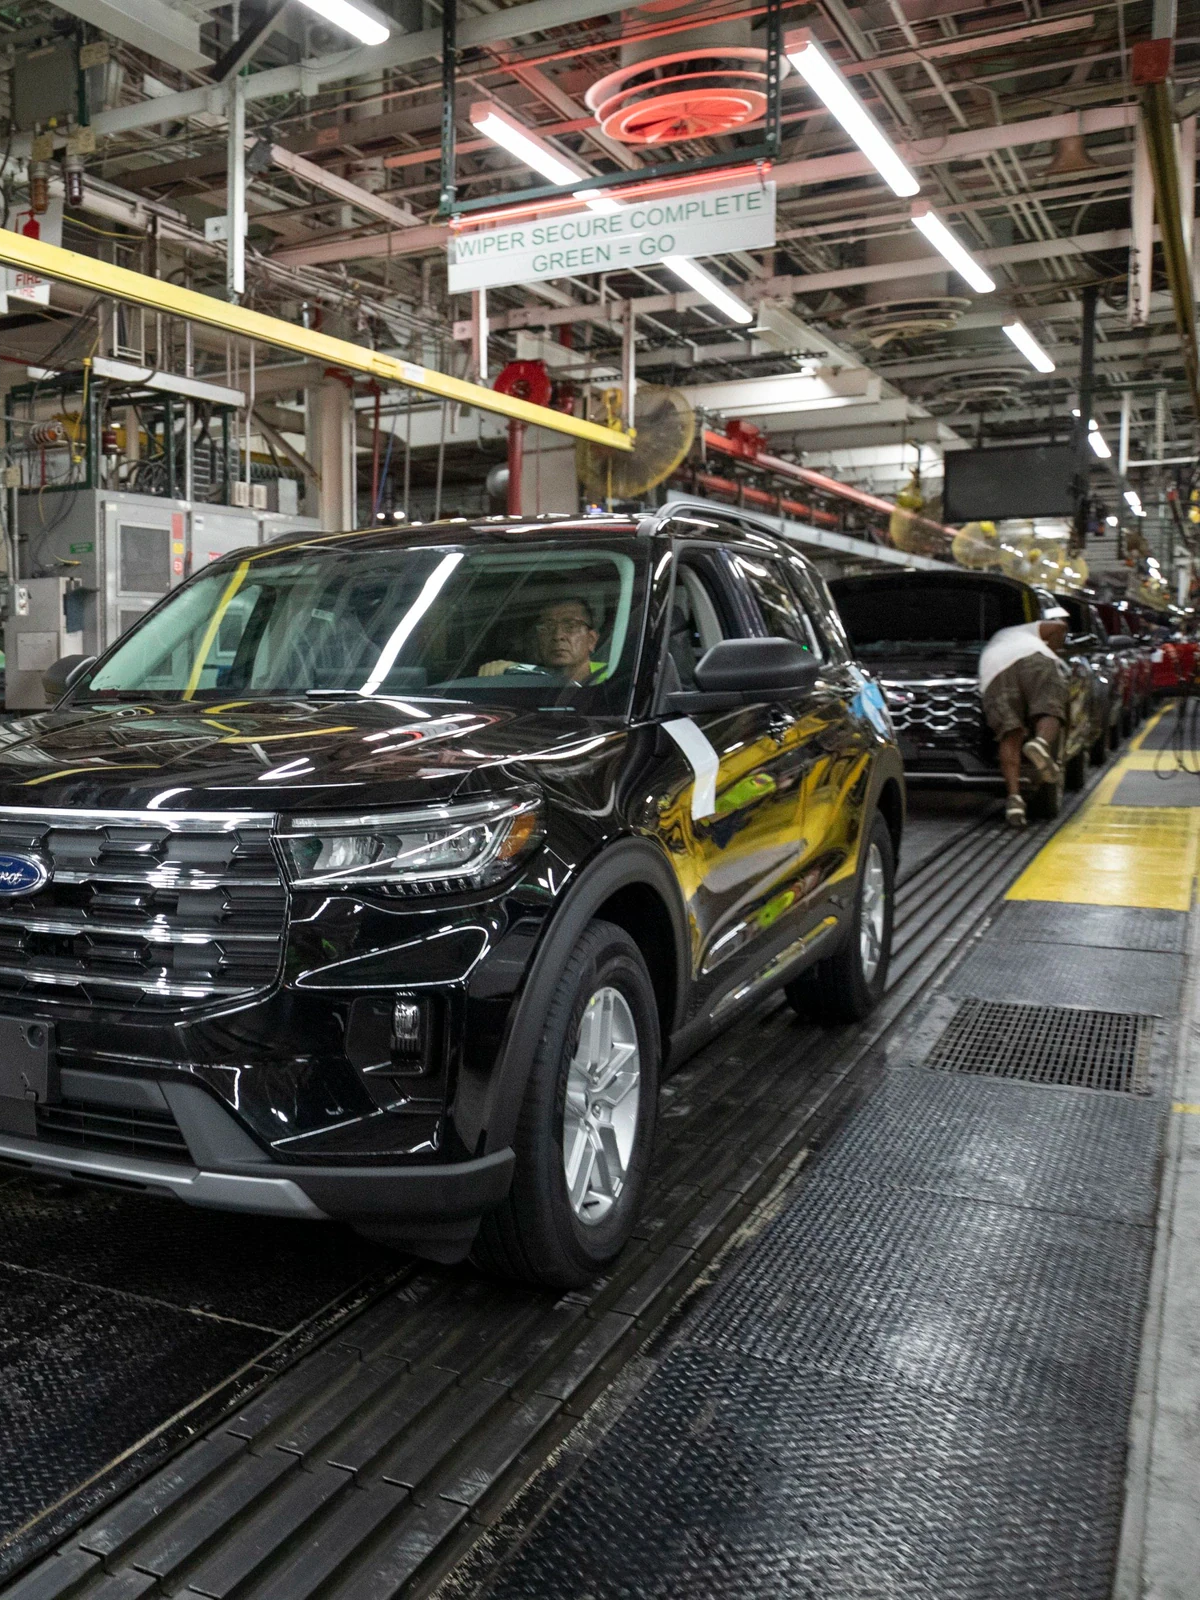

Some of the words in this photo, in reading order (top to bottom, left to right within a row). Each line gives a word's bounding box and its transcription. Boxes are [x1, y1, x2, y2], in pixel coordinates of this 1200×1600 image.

[457, 231, 524, 258] WIPER
[532, 214, 623, 246] SECURE
[630, 190, 762, 230] COMPLETE
[532, 245, 611, 273] GREEN
[639, 234, 676, 256] GO
